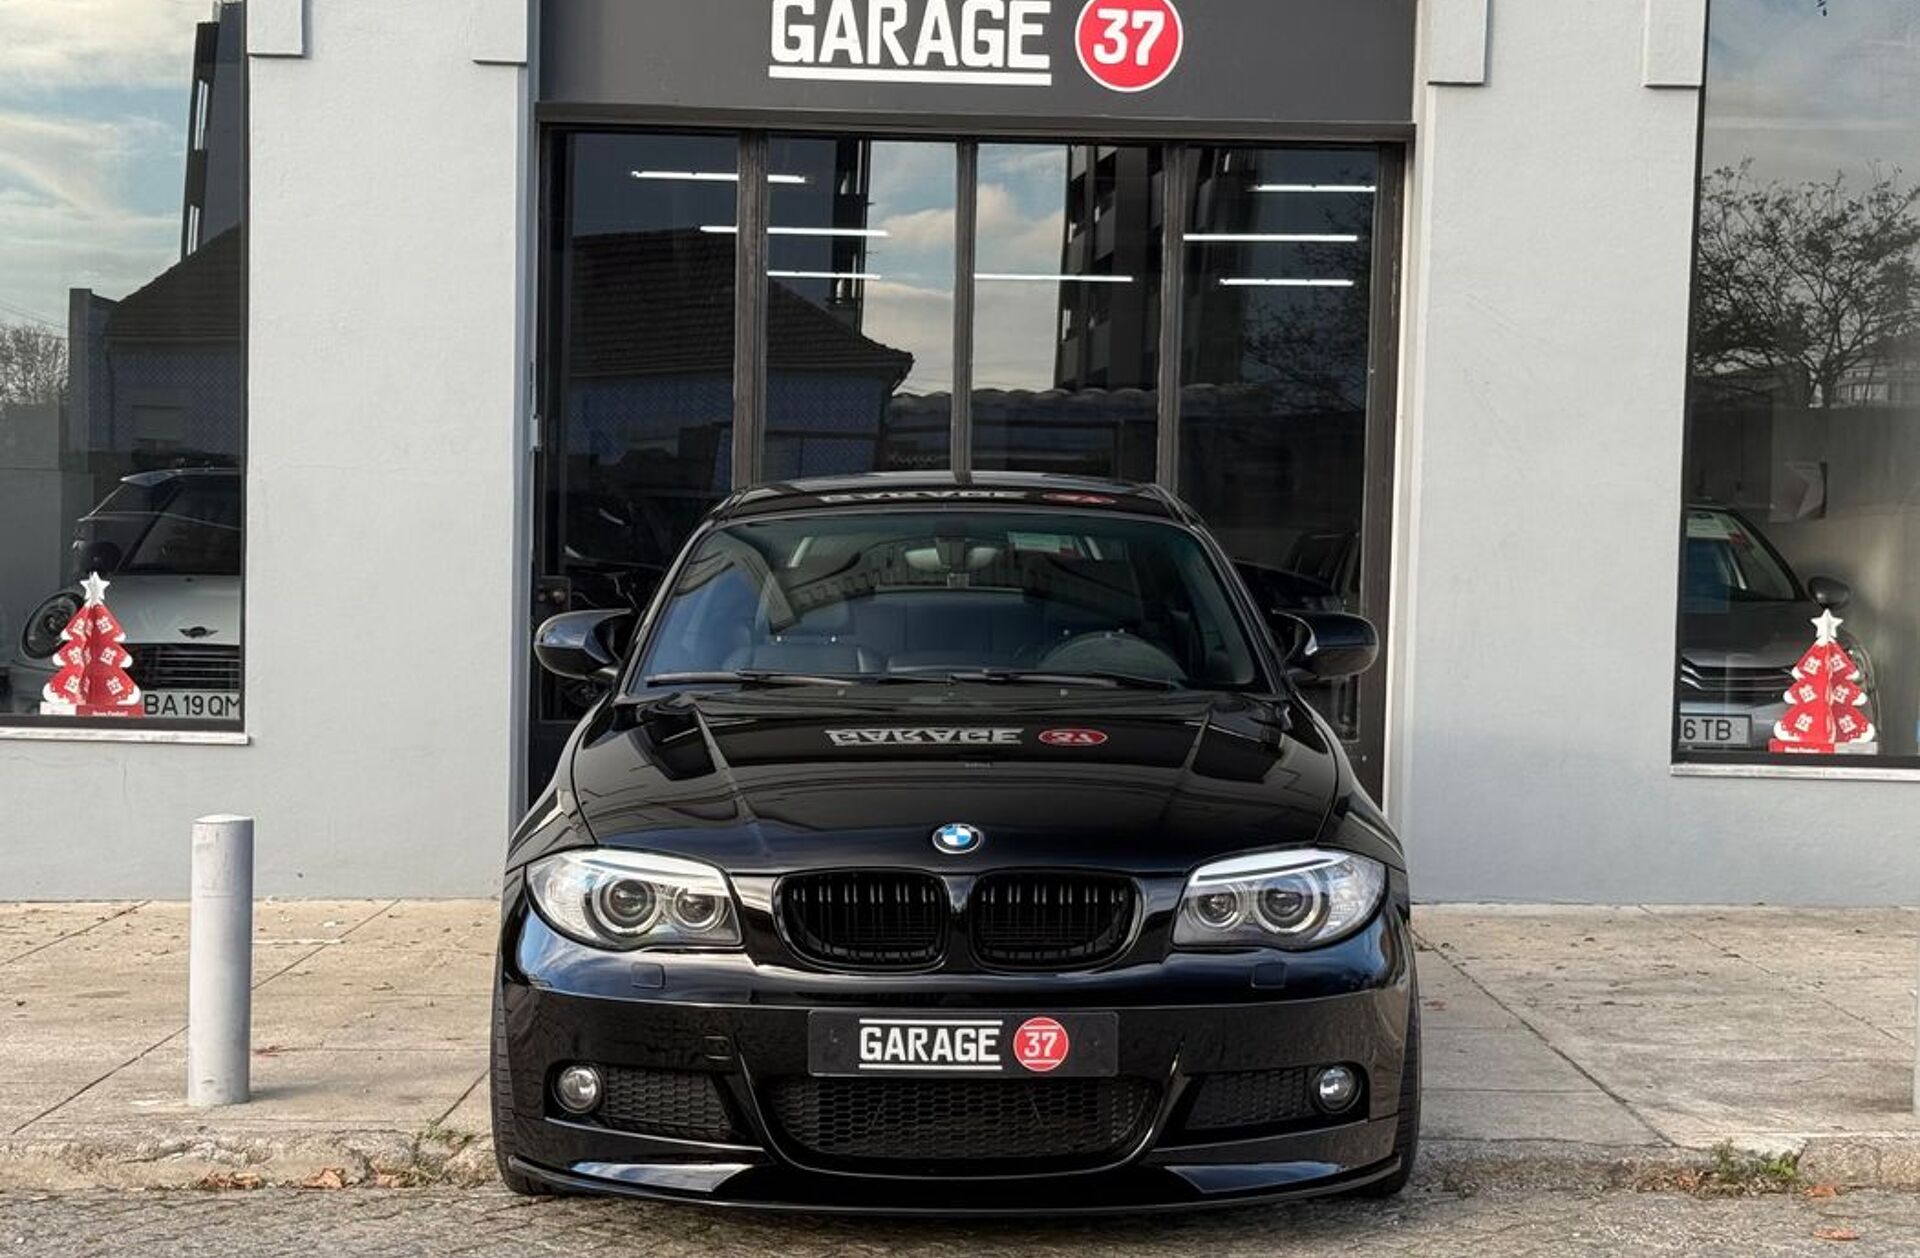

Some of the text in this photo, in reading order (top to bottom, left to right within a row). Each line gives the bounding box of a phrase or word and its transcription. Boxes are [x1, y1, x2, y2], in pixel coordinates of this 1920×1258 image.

[771, 0, 1165, 69] GARAGE 37
[144, 694, 178, 716] BA
[183, 695, 203, 716] 19
[1701, 719, 1732, 741] TB
[860, 1027, 1058, 1062] GARAGE 37
